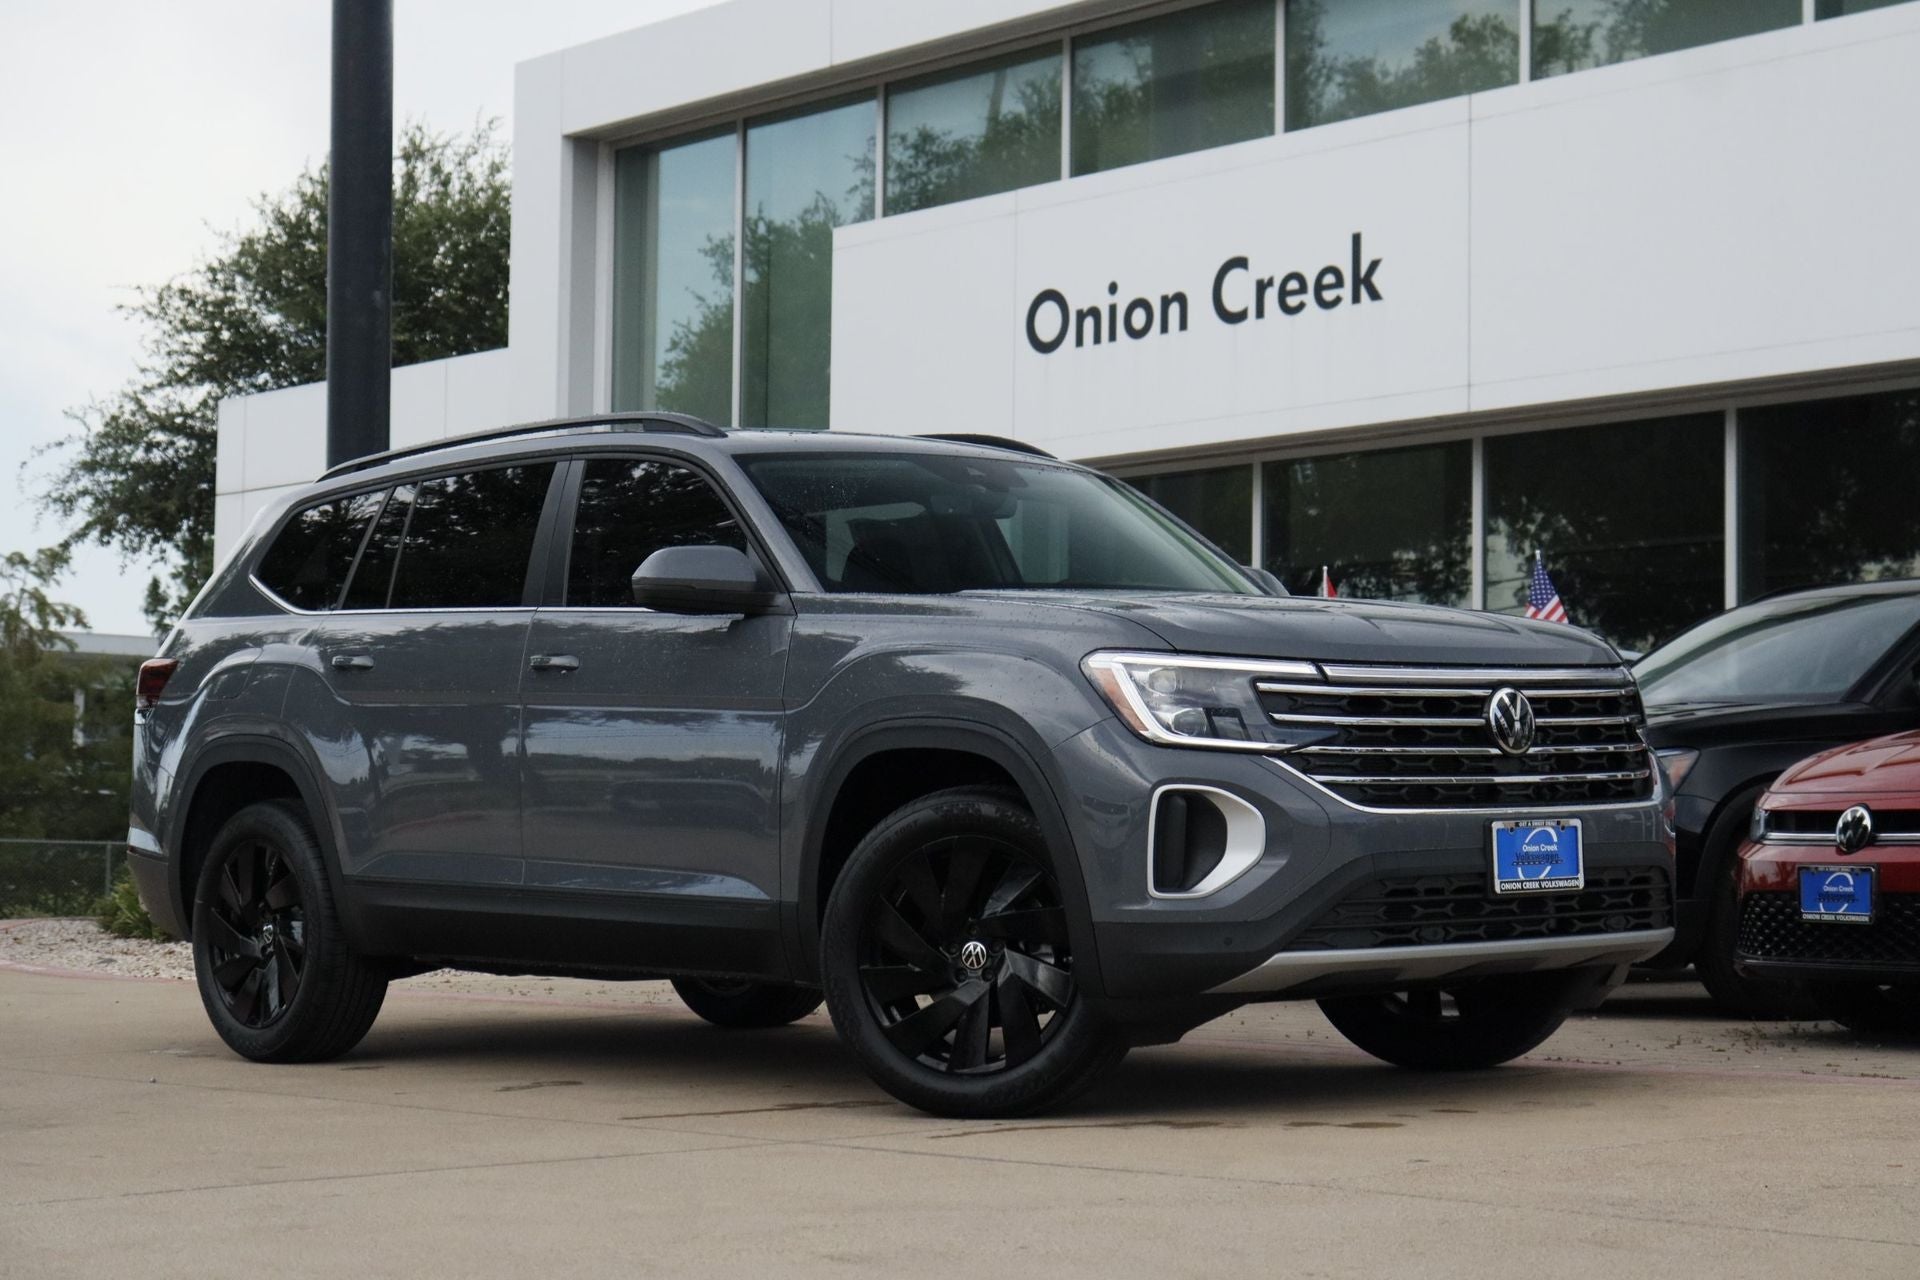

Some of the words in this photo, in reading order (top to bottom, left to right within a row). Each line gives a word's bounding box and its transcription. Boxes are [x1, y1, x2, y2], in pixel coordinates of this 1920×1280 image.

[1026, 282, 1188, 355] Onion
[1212, 232, 1383, 325] Creek
[1516, 852, 1559, 863] Volkswagen
[1501, 882, 1522, 891] ONION
[1523, 881, 1540, 890] CREEK
[1541, 880, 1580, 888] VOLKSWAGEN
